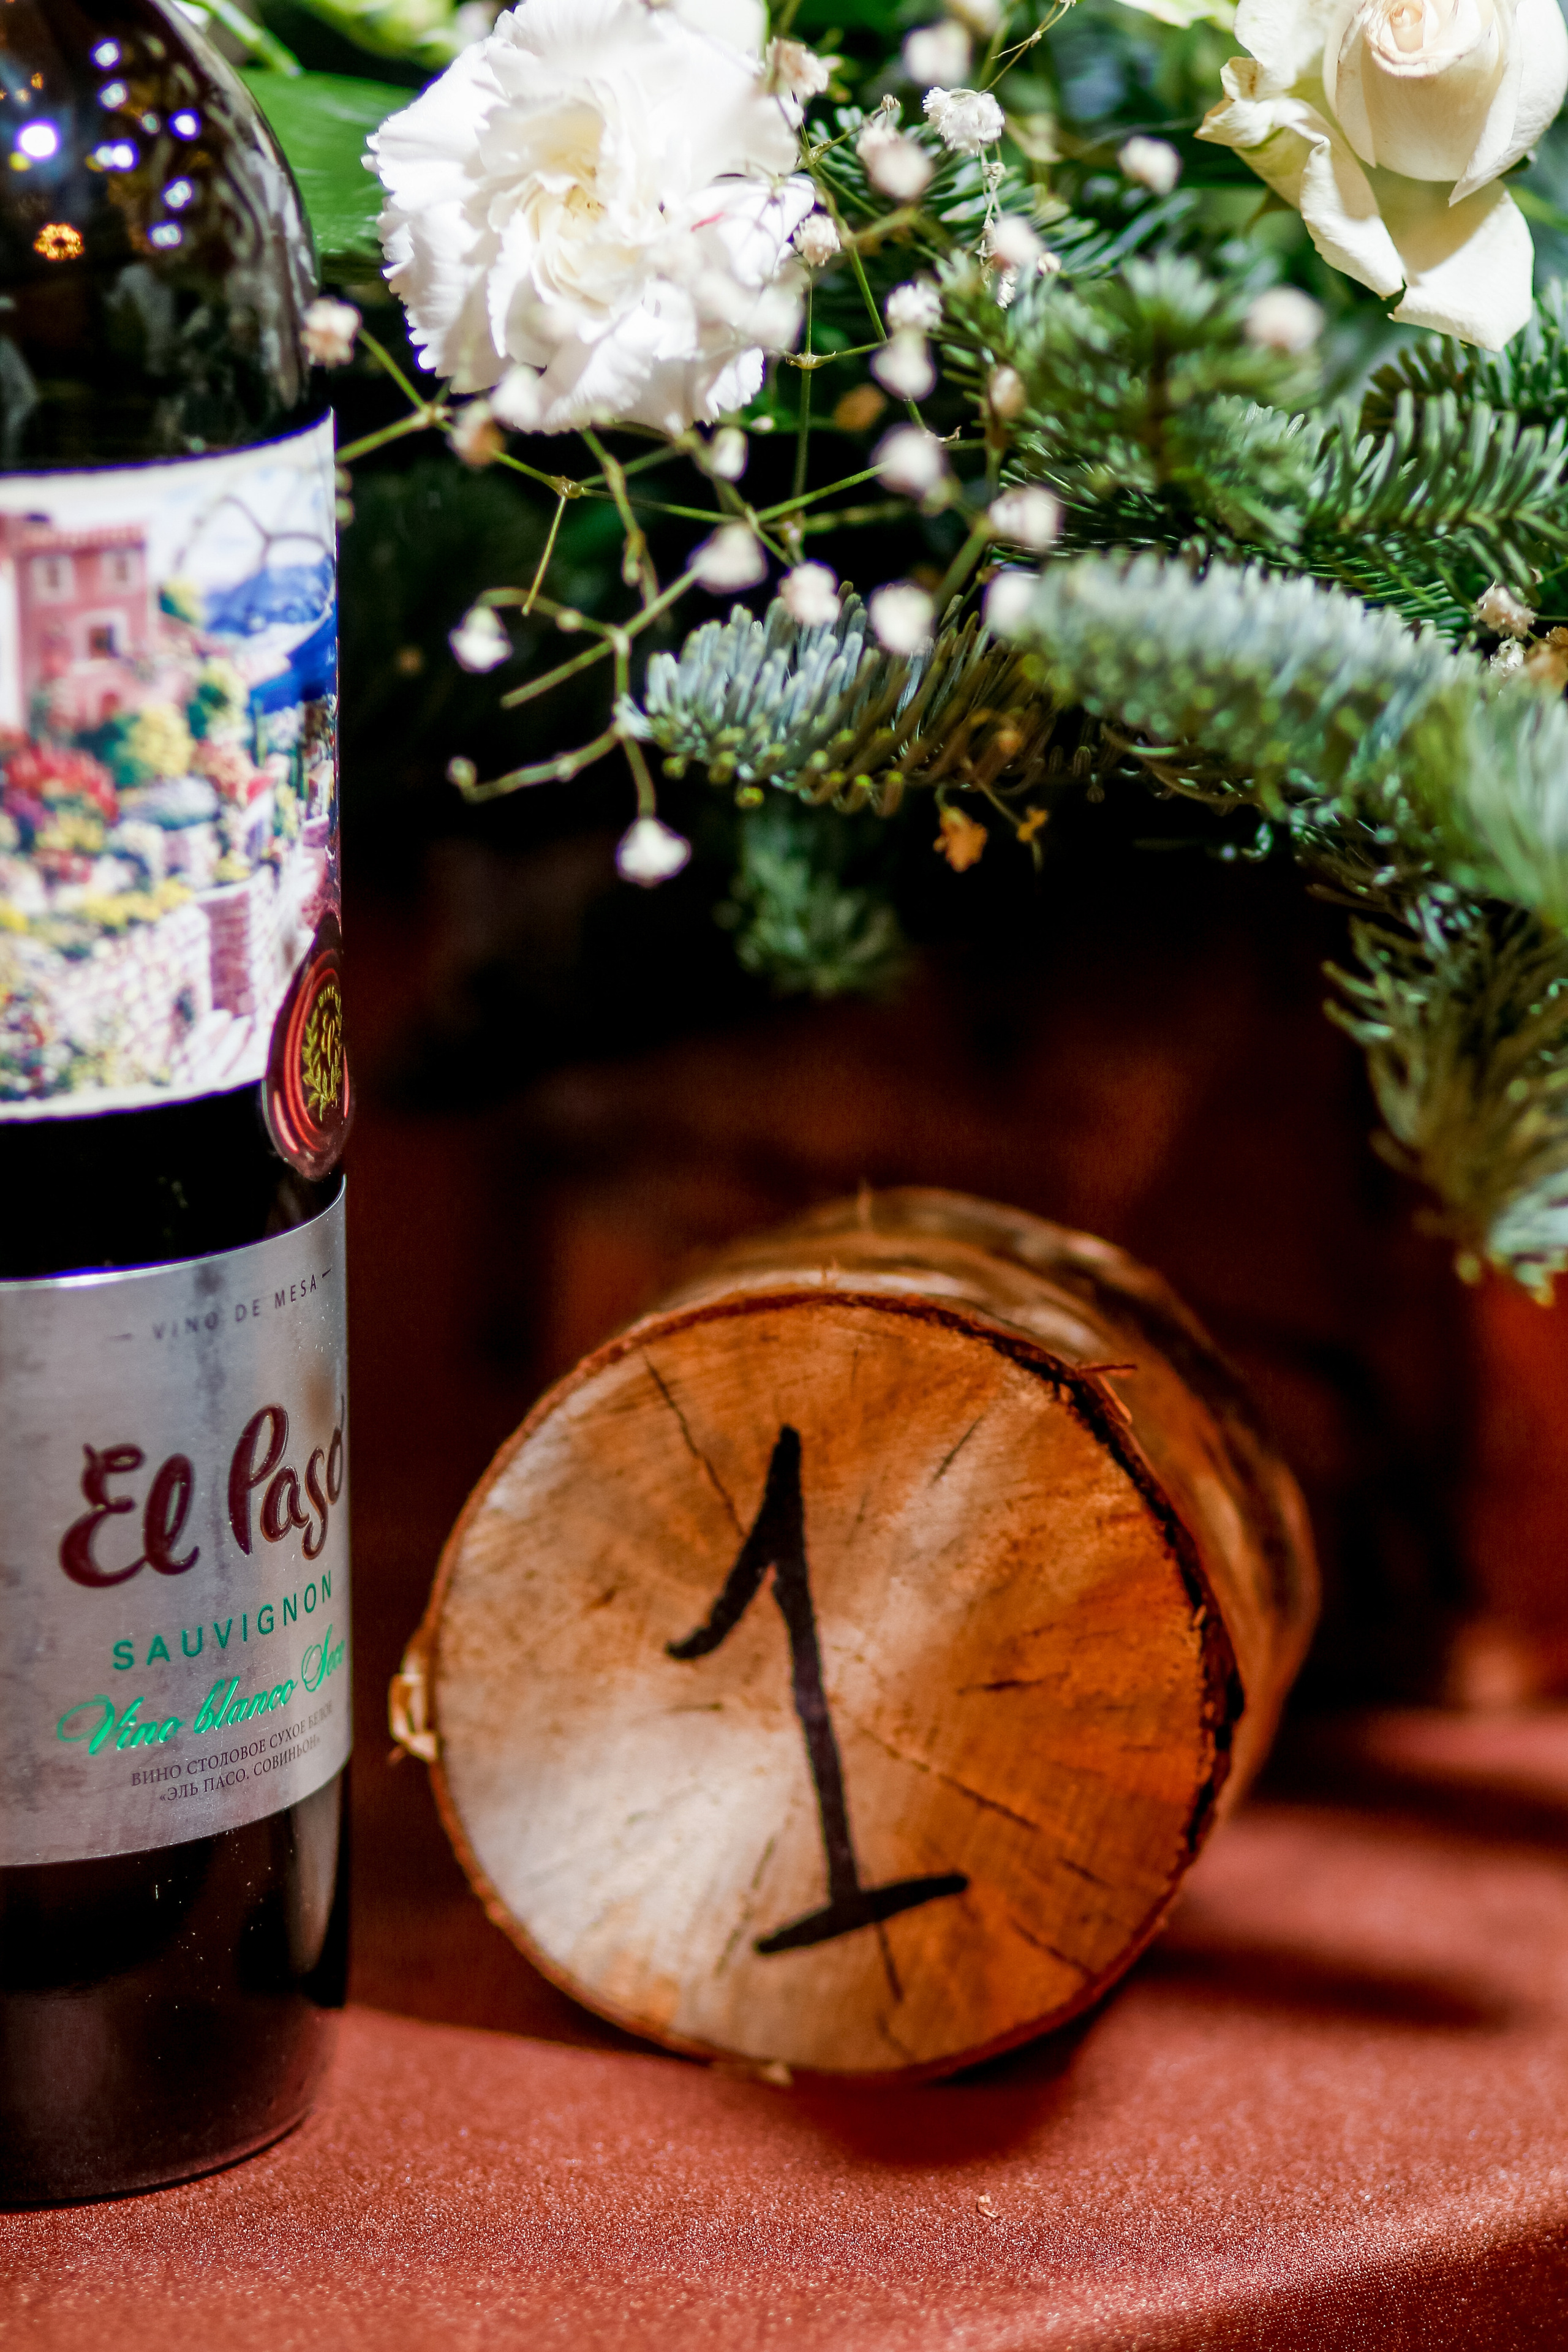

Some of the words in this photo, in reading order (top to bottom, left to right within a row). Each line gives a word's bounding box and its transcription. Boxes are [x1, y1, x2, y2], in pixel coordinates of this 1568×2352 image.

[153, 1311, 219, 1340] VINO
[235, 1298, 260, 1322] DE
[275, 1274, 317, 1309] MESA
[59, 1442, 199, 1588] El
[228, 1394, 344, 1561] Paso
[112, 1570, 332, 1670] SAUVIGNON
[56, 1694, 185, 1757] Vino
[194, 1675, 298, 1735] blanco
[665, 1424, 968, 1954] 1
[130, 1764, 182, 1787] ВИНО
[186, 1738, 266, 1775] СТОЛОВОЕ
[269, 1720, 306, 1749] СУХОЕ
[159, 1782, 199, 1802] «ЭЛЬ
[203, 1768, 250, 1793] ПАСО.
